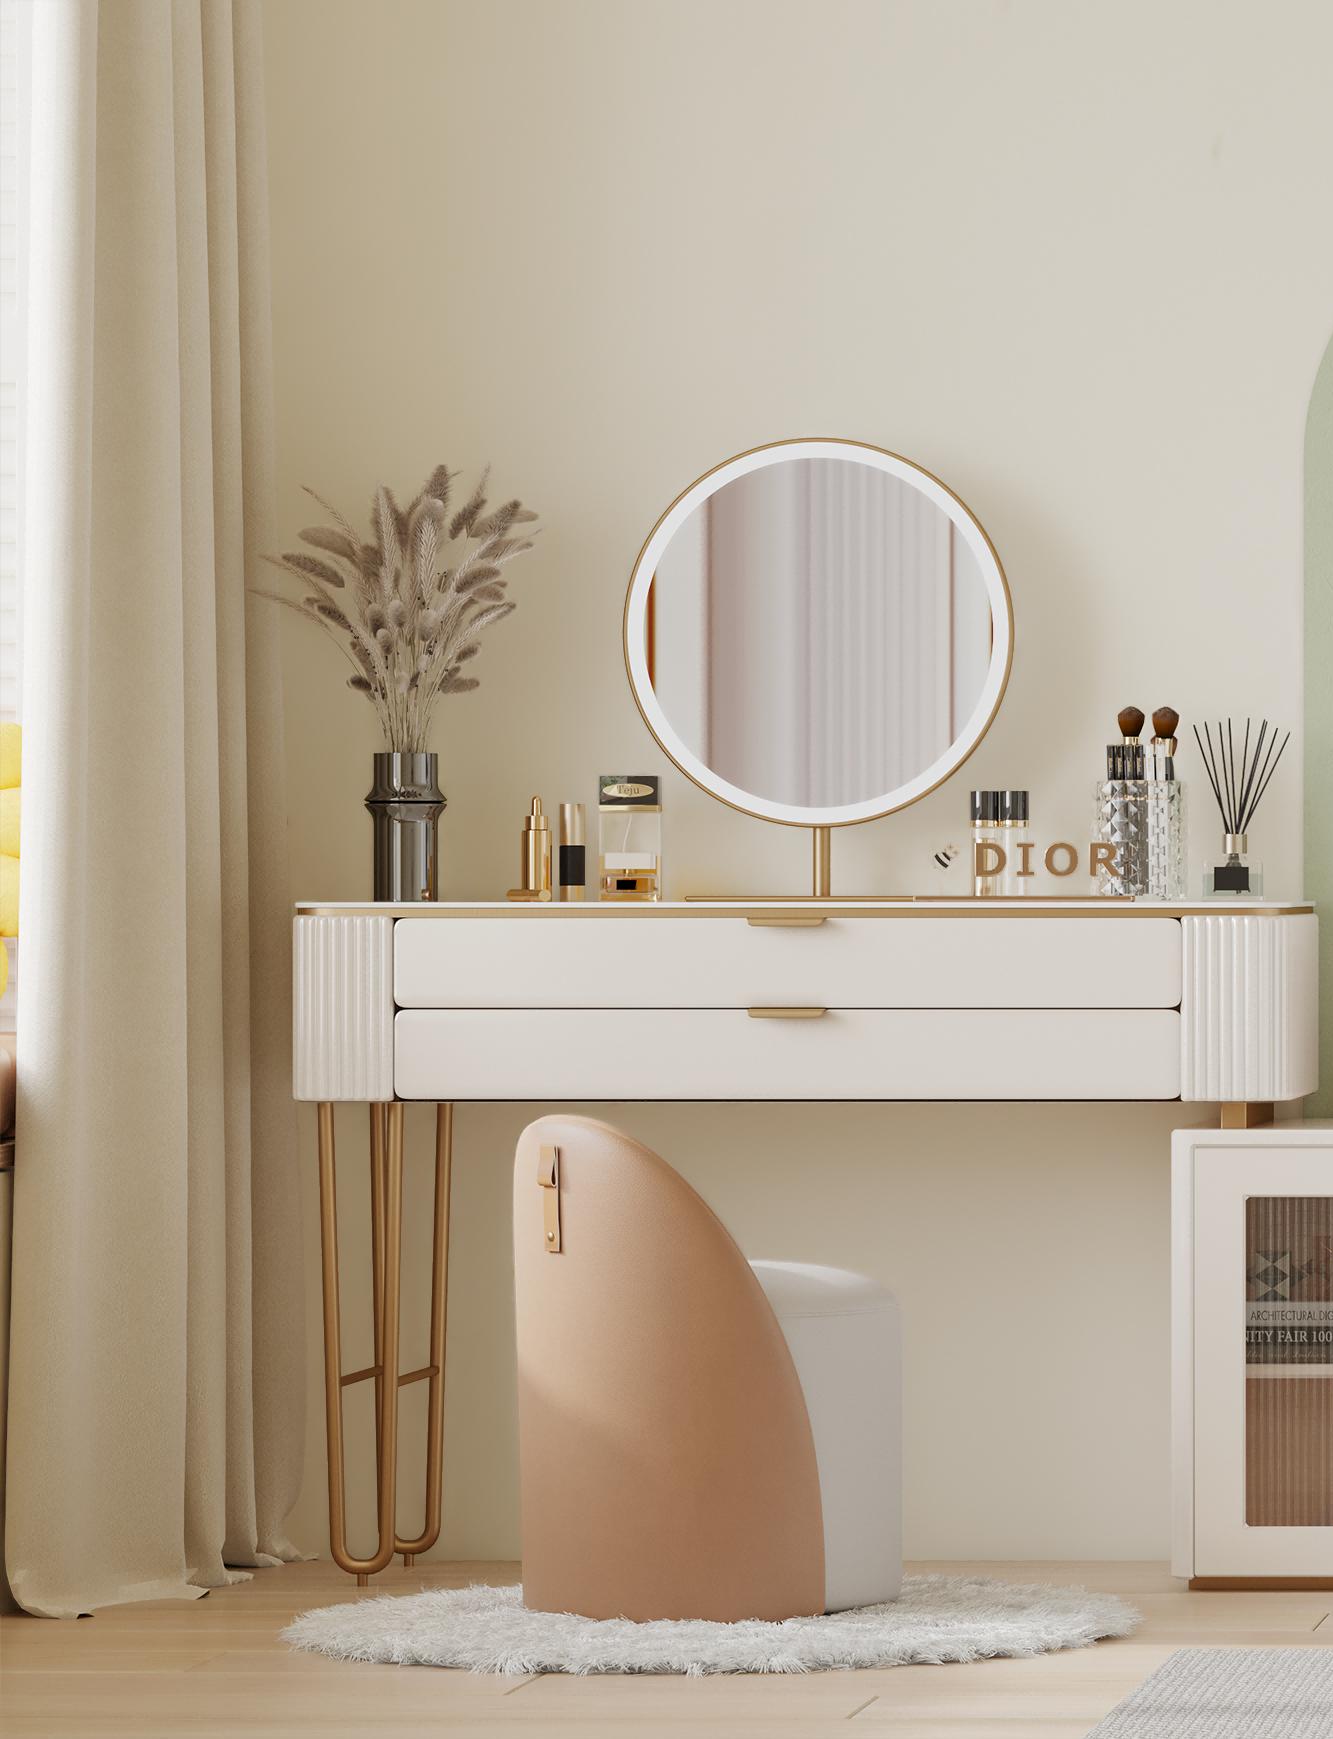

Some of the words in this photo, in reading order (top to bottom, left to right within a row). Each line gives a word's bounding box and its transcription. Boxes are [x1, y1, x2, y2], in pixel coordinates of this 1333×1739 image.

[617, 784, 640, 796] Teju
[974, 842, 1121, 877] DIOR
[1250, 1310, 1317, 1321] ARCHITECTURAL
[1277, 1331, 1308, 1343] FAIR
[1312, 1331, 1333, 1343] 100
